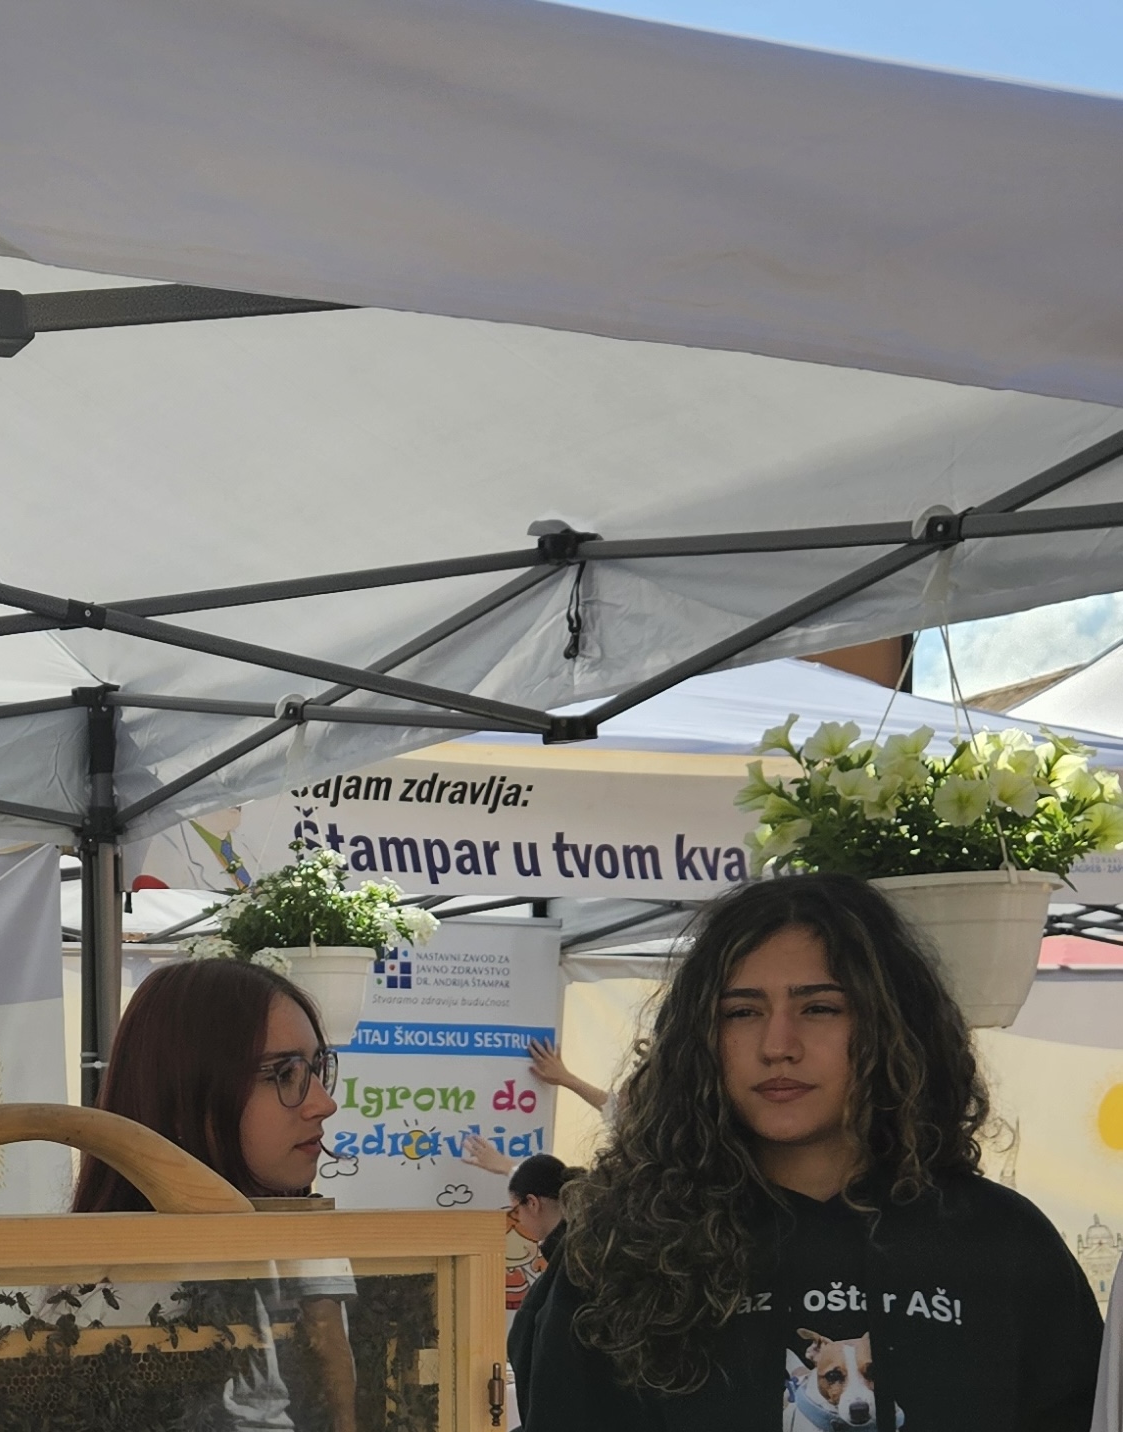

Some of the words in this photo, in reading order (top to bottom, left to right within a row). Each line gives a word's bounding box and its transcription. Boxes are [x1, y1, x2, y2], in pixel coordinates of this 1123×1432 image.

[291, 774, 393, 808] ajam
[399, 772, 534, 813] zdravlja:
[293, 806, 501, 885] Štampar
[512, 840, 542, 877] u
[552, 831, 663, 881] tvom
[675, 833, 750, 883] kva
[415, 965, 449, 975] JAVNO
[451, 965, 510, 976] ZDRAVSTVO
[416, 952, 461, 962] NASTAVNI
[462, 953, 495, 963] ZAVOD
[497, 954, 510, 964] ZA
[416, 977, 430, 986] DR.
[433, 978, 469, 988] ANDRIJA
[471, 977, 510, 988] ŠTAMPAR
[394, 1025, 469, 1047] ŠKOLSKU
[473, 1032, 531, 1050] SESTRU
[340, 1077, 476, 1118] Igrom
[492, 1080, 537, 1114] do
[906, 1287, 963, 1326] AŠ!
